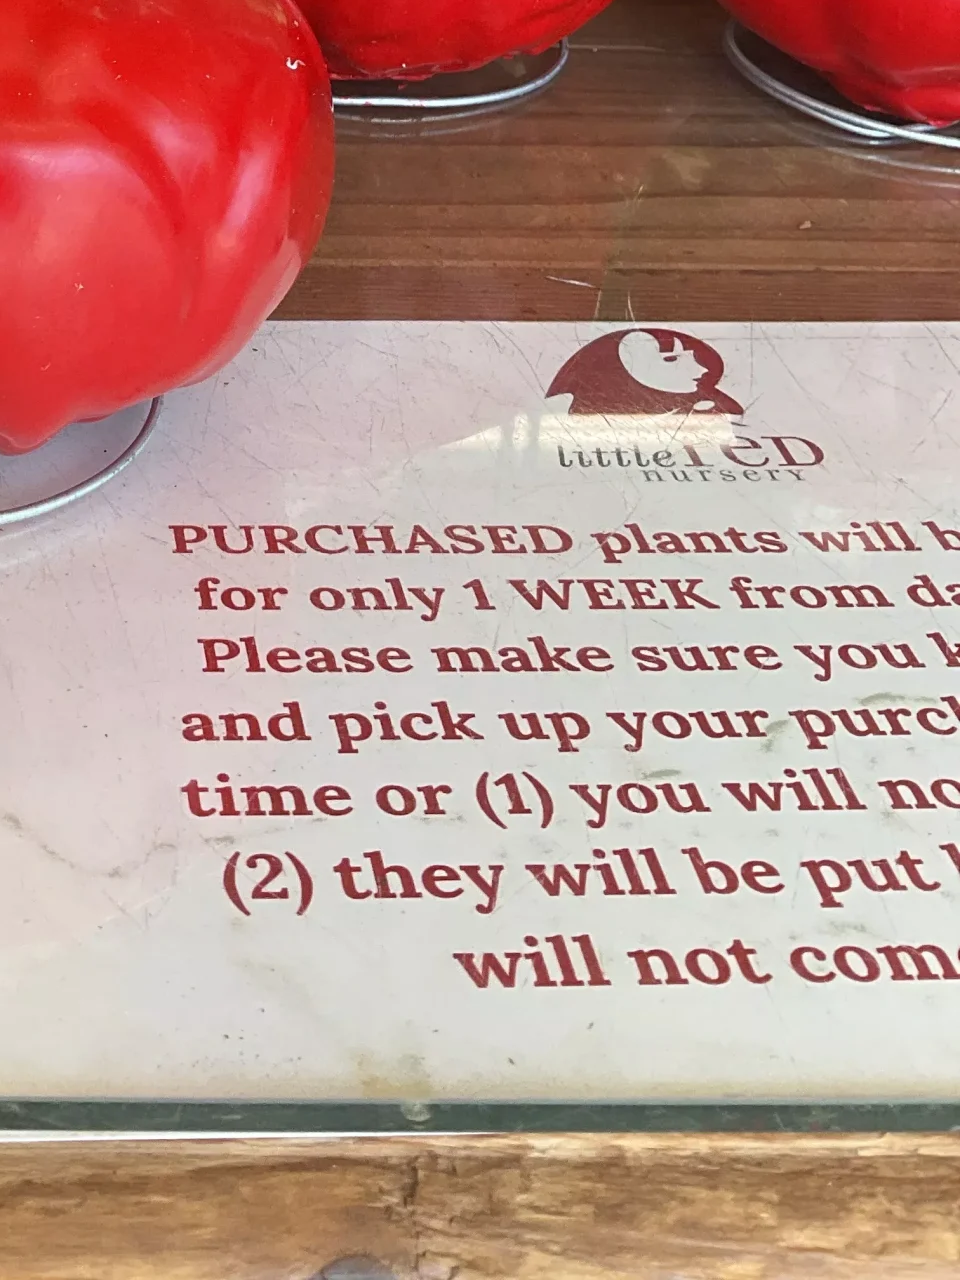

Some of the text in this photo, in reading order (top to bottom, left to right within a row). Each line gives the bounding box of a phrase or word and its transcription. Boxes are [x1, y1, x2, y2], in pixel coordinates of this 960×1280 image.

[167, 524, 573, 555] PURCHASED
[591, 523, 787, 564] plants
[801, 521, 922, 552] will
[193, 576, 289, 611] for
[309, 577, 445, 622] only
[463, 578, 495, 611] 1
[508, 578, 720, 611] WEEK
[729, 576, 894, 609] from
[196, 635, 413, 674] Please
[431, 635, 613, 673] make
[631, 645, 782, 672] sure
[795, 643, 926, 682] you
[181, 701, 312, 742] and
[328, 700, 484, 754] pick
[498, 712, 591, 753] up
[606, 710, 770, 753] your
[180, 772, 353, 818] time
[375, 784, 453, 816] or
[475, 771, 554, 829] (1)
[569, 782, 712, 829] you
[722, 767, 867, 812] will
[222, 851, 314, 916] (2)
[333, 850, 505, 915] they
[524, 847, 677, 897] will
[681, 847, 785, 895] be
[799, 850, 942, 908] put
[453, 934, 960, 989] will not com
